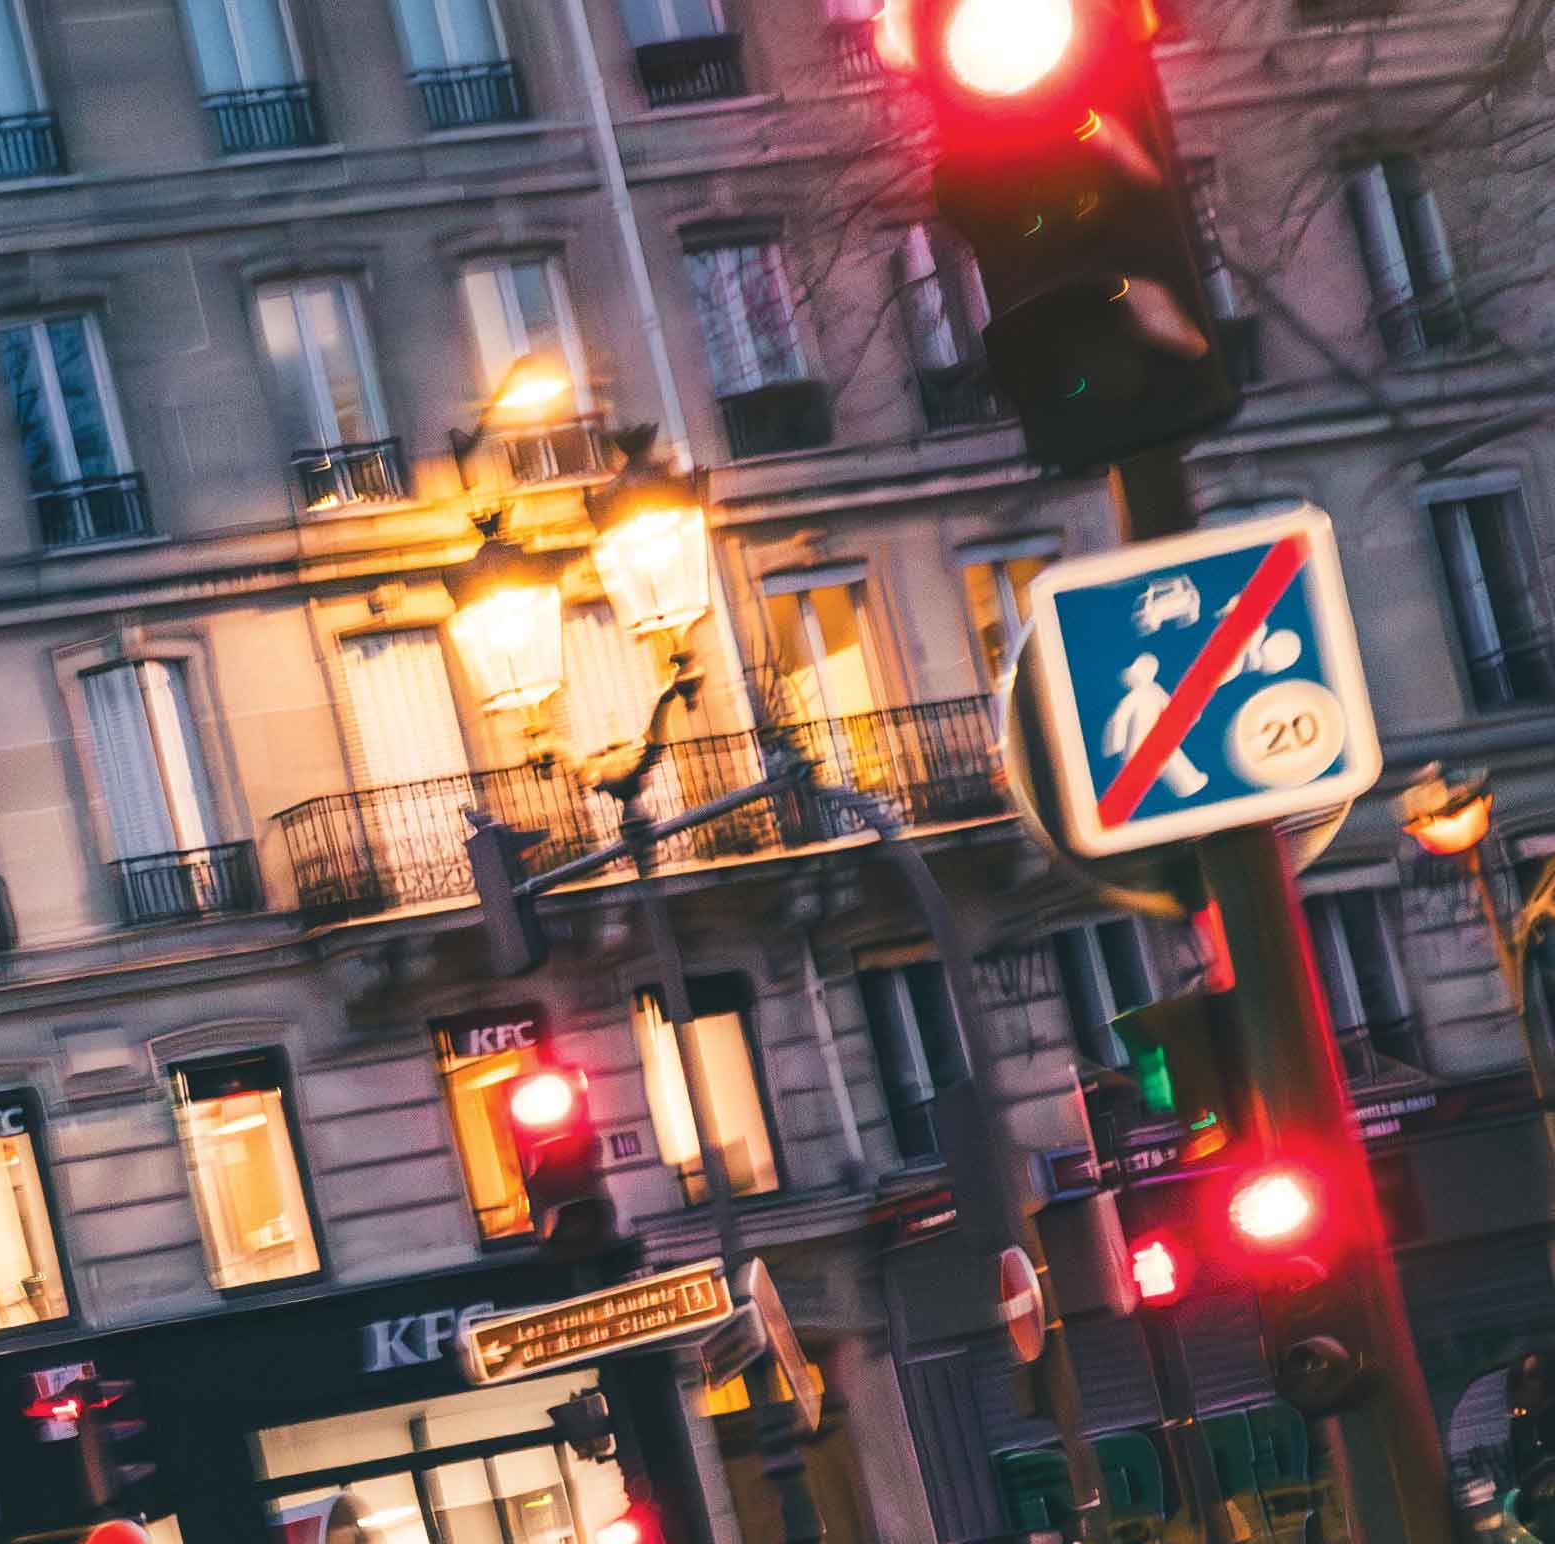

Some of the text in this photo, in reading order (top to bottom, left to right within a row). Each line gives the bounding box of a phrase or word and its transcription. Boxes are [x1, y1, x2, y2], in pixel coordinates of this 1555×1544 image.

[1259, 710, 1319, 761] 20
[469, 1020, 535, 1055] KFC
[619, 1308, 678, 1335] Clichy
